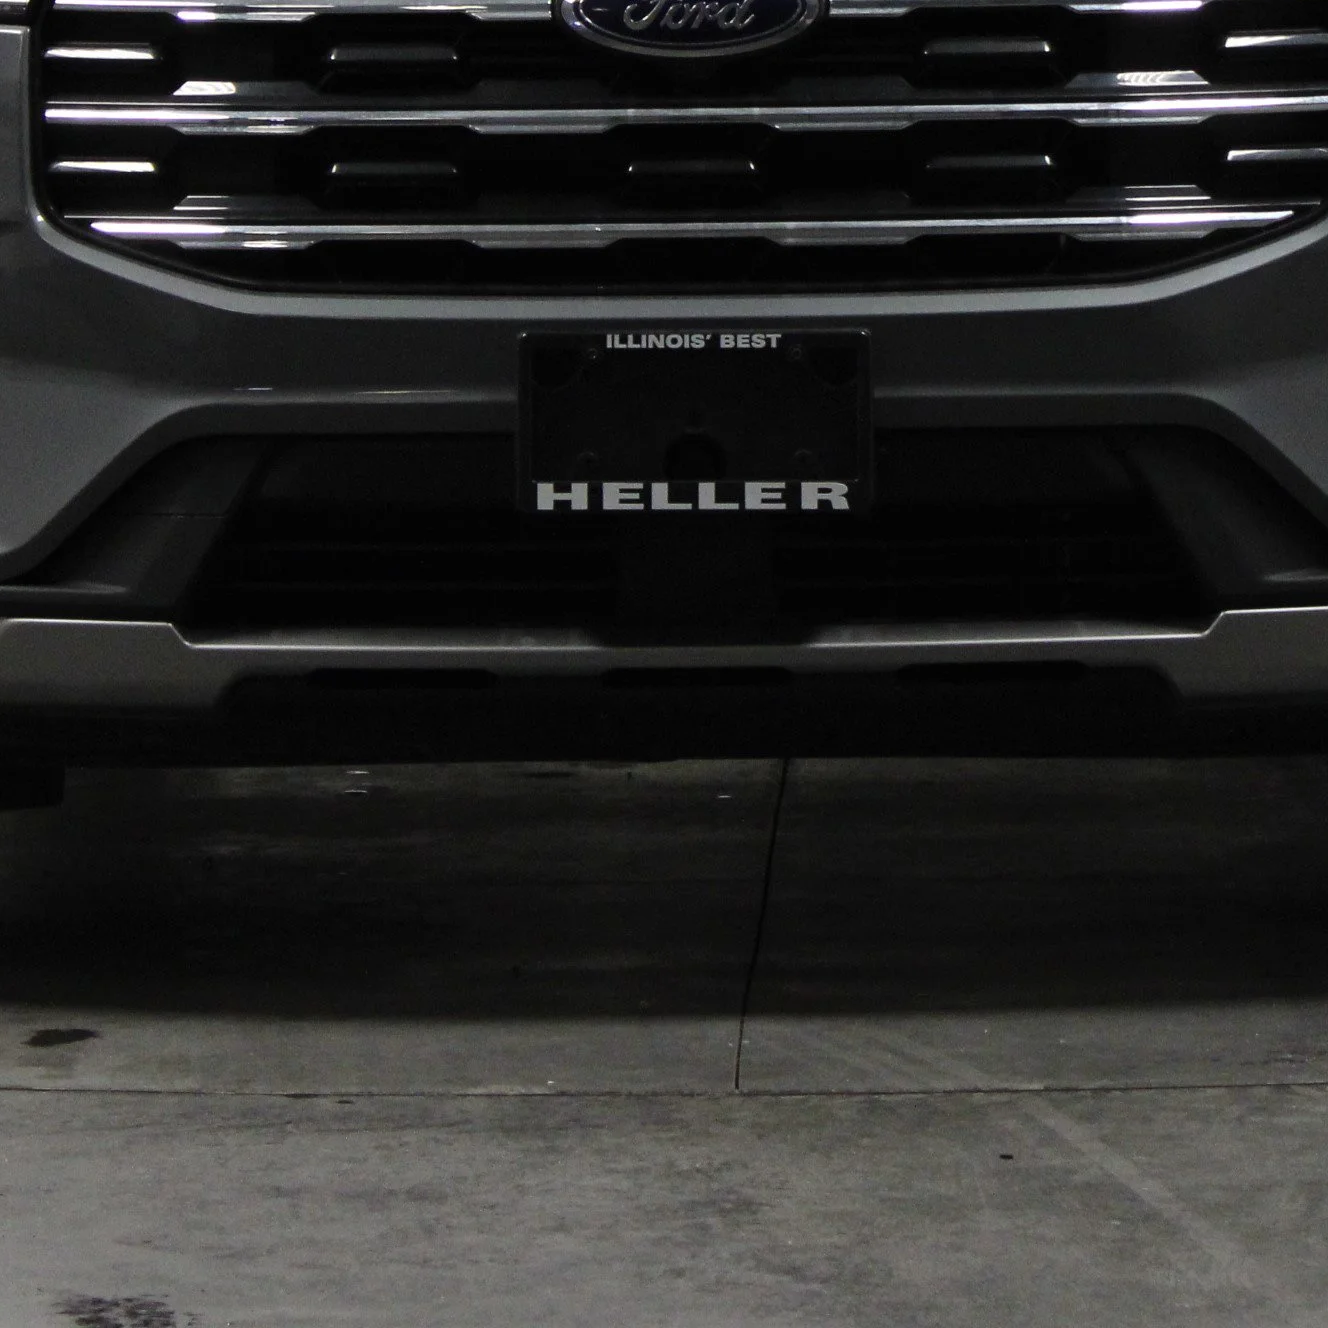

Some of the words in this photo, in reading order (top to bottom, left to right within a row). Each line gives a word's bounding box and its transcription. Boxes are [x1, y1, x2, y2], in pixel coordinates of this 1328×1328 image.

[606, 333, 712, 349] ILLINOIS'
[719, 333, 782, 349] BEST
[536, 482, 849, 511] HELLER
